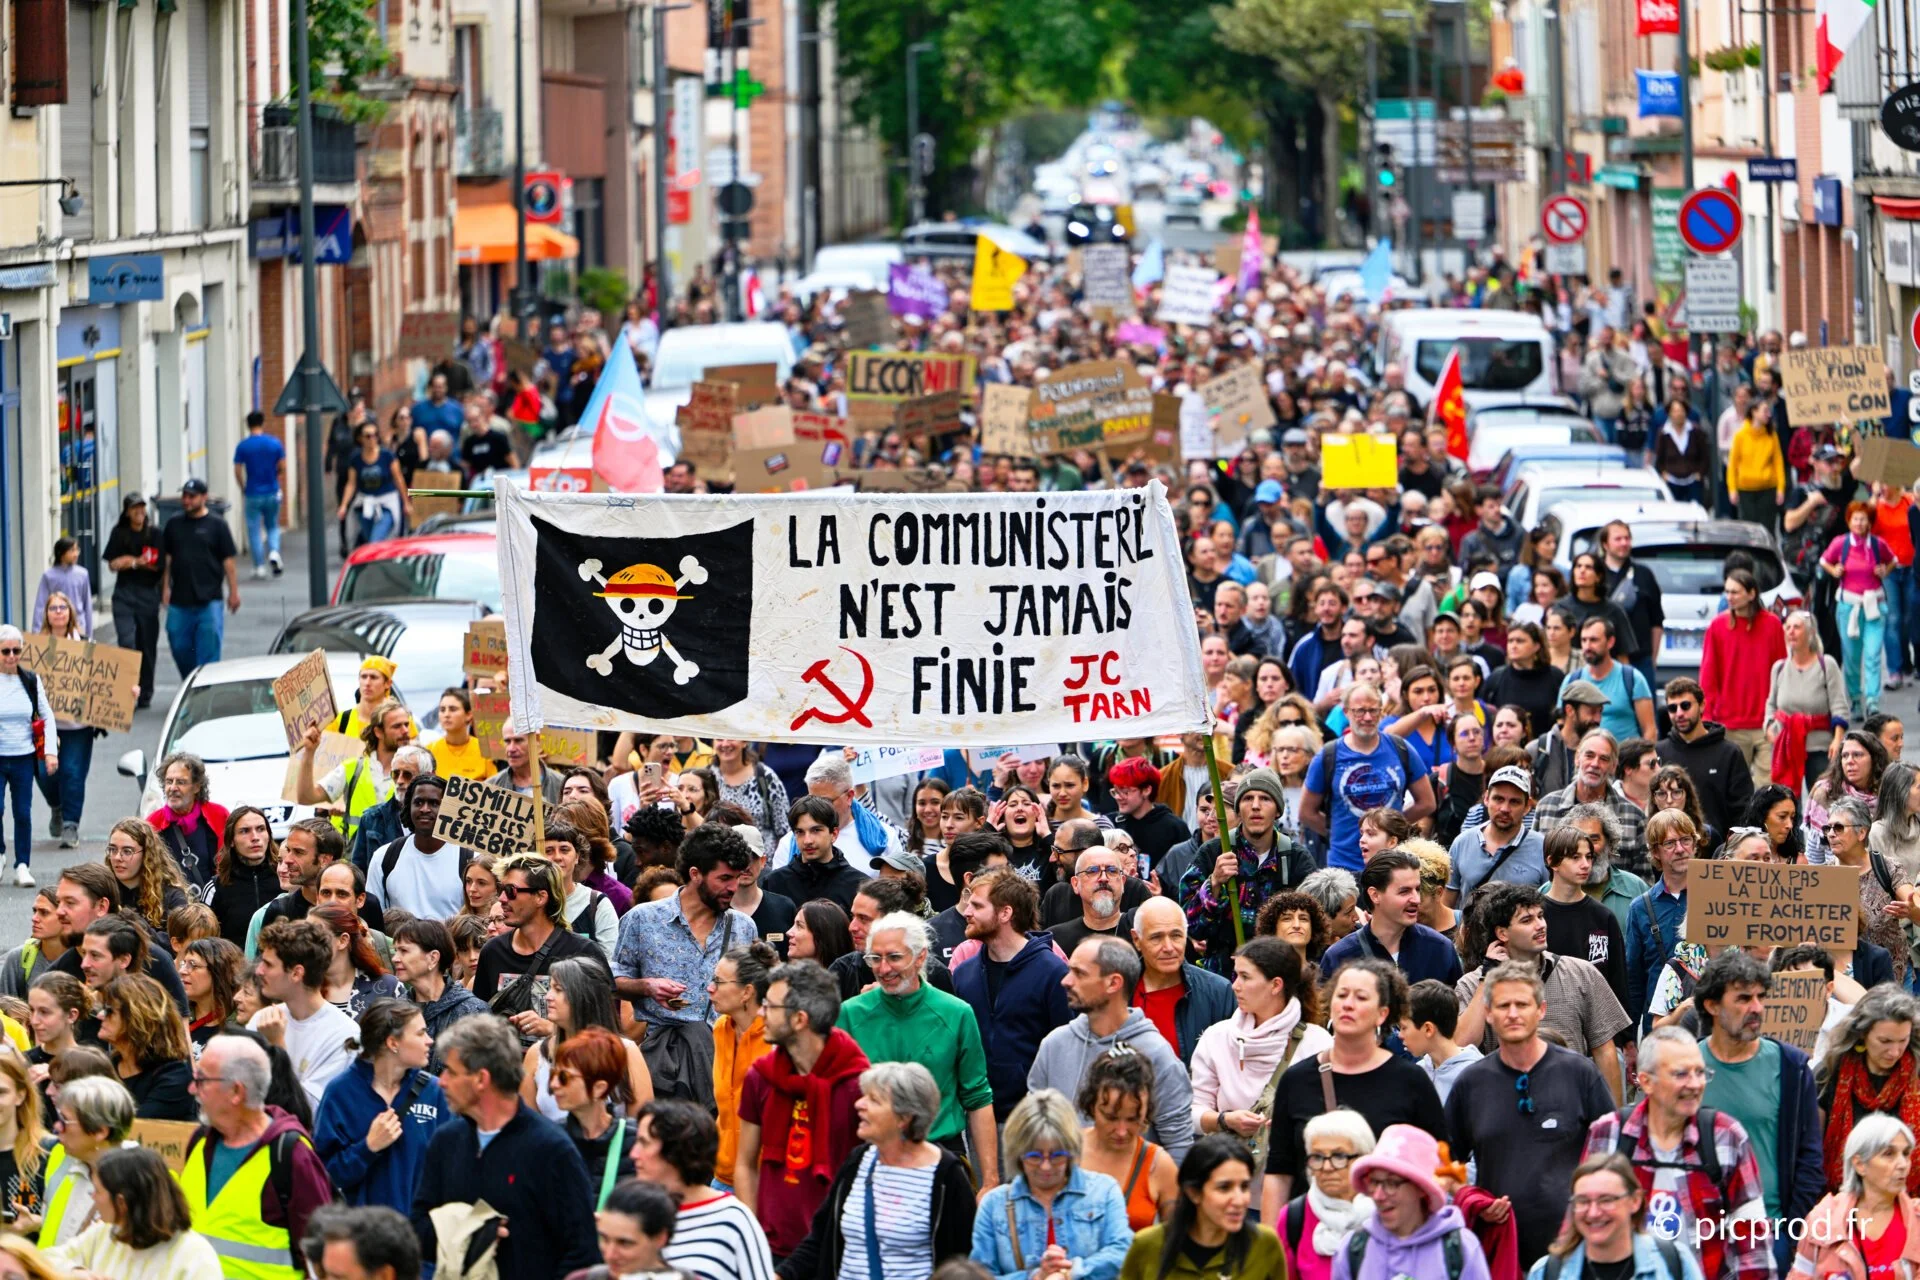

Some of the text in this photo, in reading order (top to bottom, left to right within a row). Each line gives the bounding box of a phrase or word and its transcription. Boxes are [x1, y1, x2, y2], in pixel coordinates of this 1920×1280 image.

[1847, 393, 1887, 412] CON
[789, 515, 840, 568] LA
[840, 579, 955, 639] N'EST
[52, 651, 119, 681] ZUKMAN
[1064, 651, 1120, 690] JC
[58, 675, 113, 698] SERVICES
[1064, 688, 1151, 722] TARN
[857, 751, 871, 766] LA
[458, 806, 498, 829] C'EST
[499, 819, 526, 838] LES
[438, 814, 536, 857] TÉNÈBRE
[1699, 864, 1820, 888] JE VEUX PAS
[1728, 883, 1804, 901] LA LUNE
[1704, 902, 1852, 921] JUSTE ACHETER
[1707, 924, 1845, 944] DU FROMAGE
[1763, 1005, 1808, 1024] TTEND
